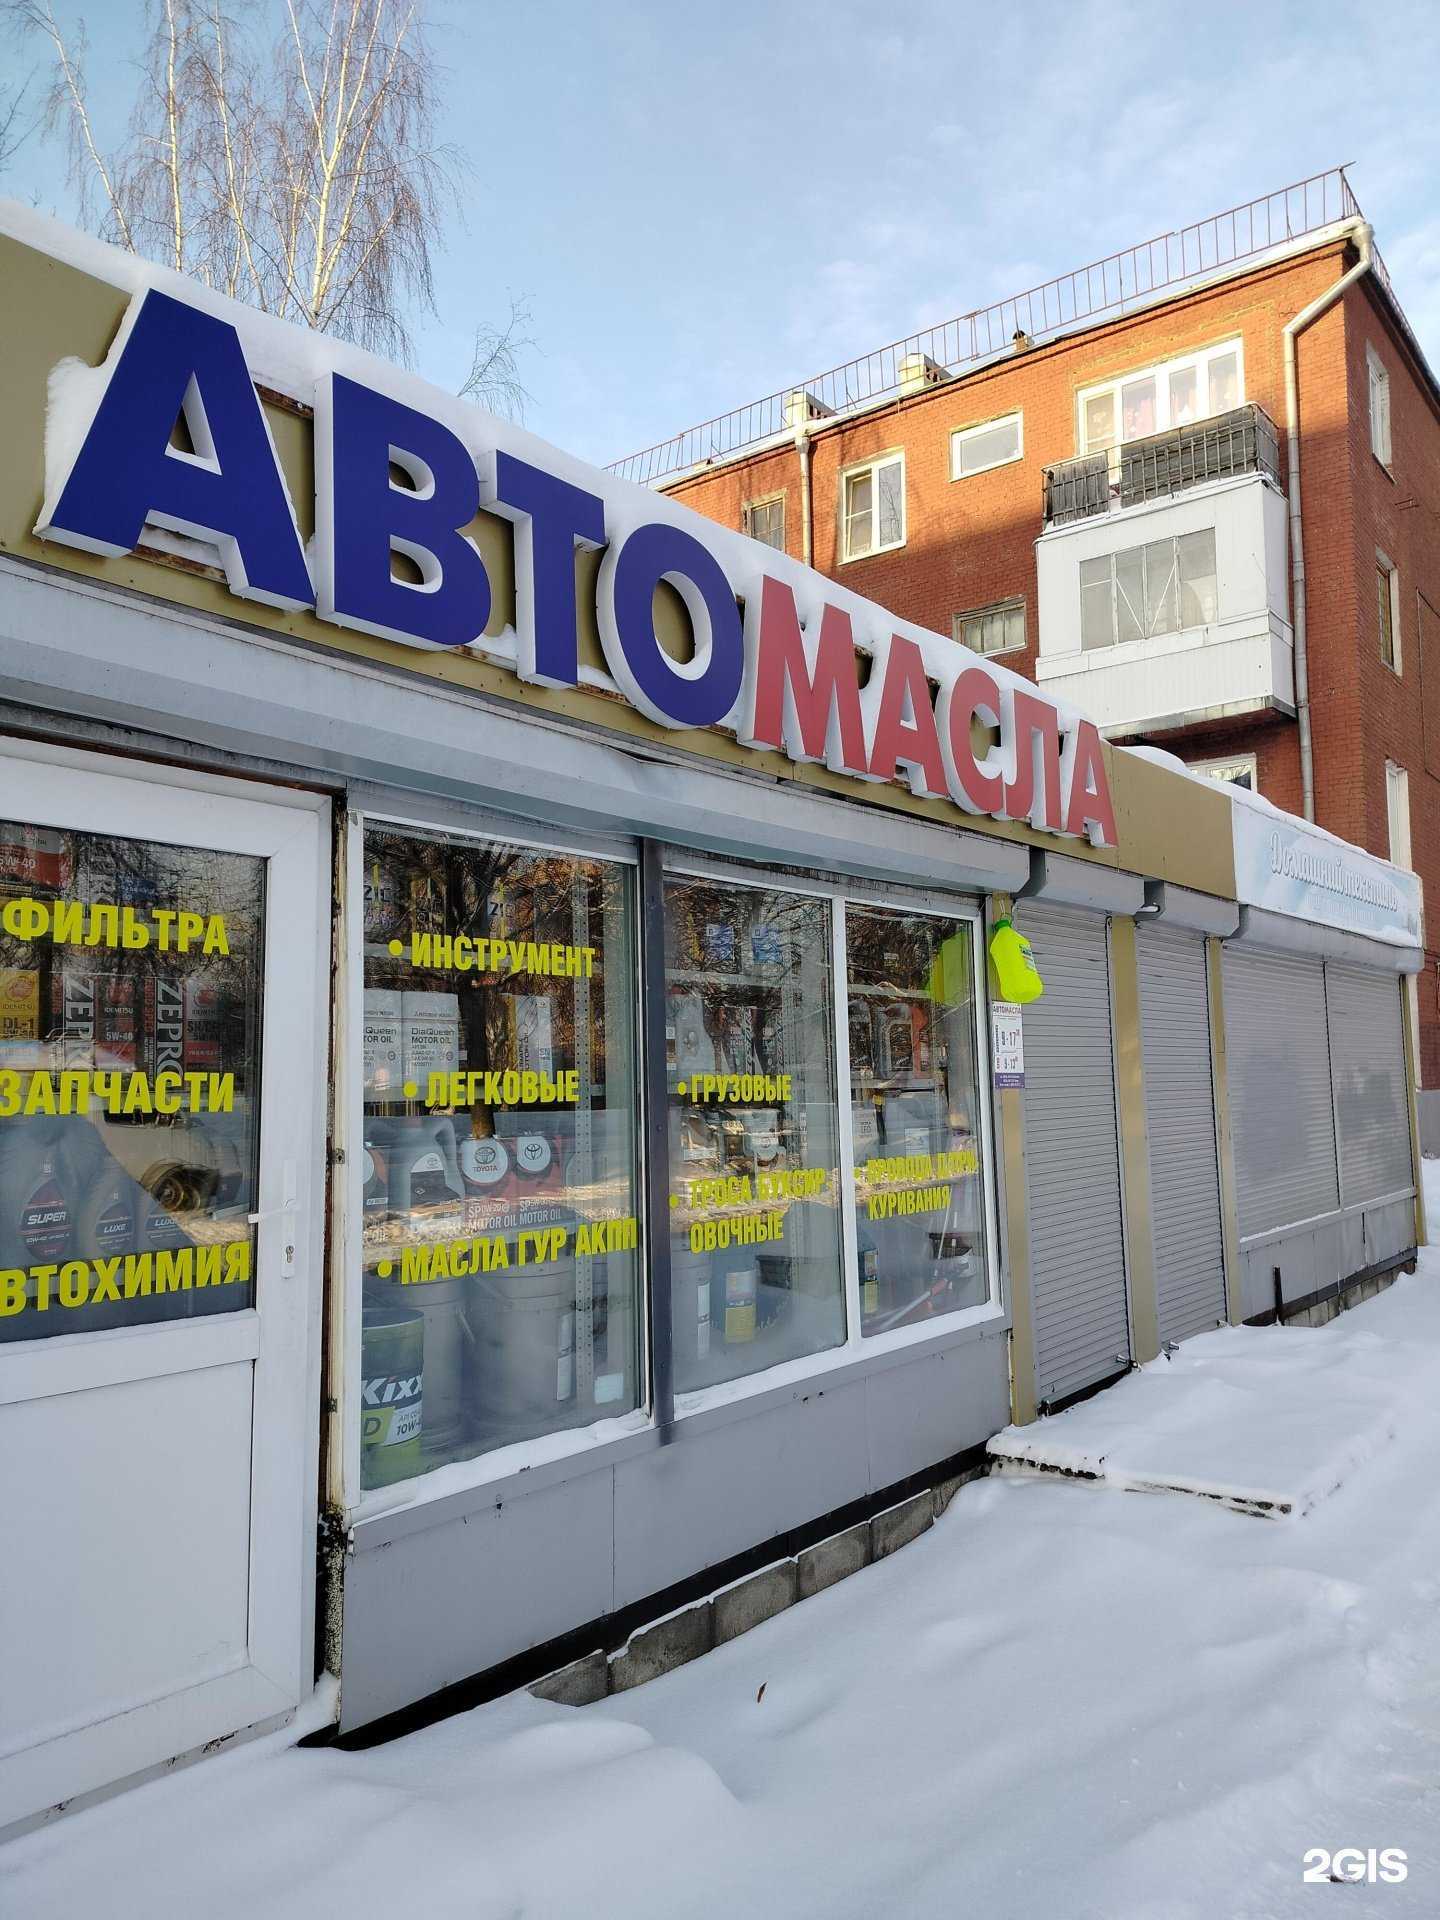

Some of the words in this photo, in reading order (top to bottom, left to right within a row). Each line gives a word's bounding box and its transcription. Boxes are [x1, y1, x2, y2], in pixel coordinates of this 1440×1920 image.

[33, 288, 1118, 848] АВТОМАСЛА
[2, 896, 230, 956] ФИЛЬТРА
[411, 931, 595, 978] ИНСТРУМЕНТ
[0, 1070, 235, 1117] ЗАПЧАСТИ
[425, 1070, 580, 1107] ЛЕГКОВЫЕ
[690, 1073, 792, 1103] ГРУЗОВЫЕ
[472, 1165, 498, 1173] TOYOTA
[688, 1175, 752, 1210] ТРОСА
[868, 1185, 951, 1220] КУРИВАНИЯ
[27, 1211, 66, 1225] SUPER
[103, 1223, 126, 1234] LUXE
[503, 1214, 517, 1227] OIL
[520, 1210, 549, 1225] MOTOR
[550, 1207, 561, 1221] OIL
[689, 1211, 784, 1254] ОВОЧНЫЕ
[401, 1236, 510, 1285] МАСЛА
[517, 1227, 567, 1266] ГУР
[575, 1217, 638, 1258] АКПП
